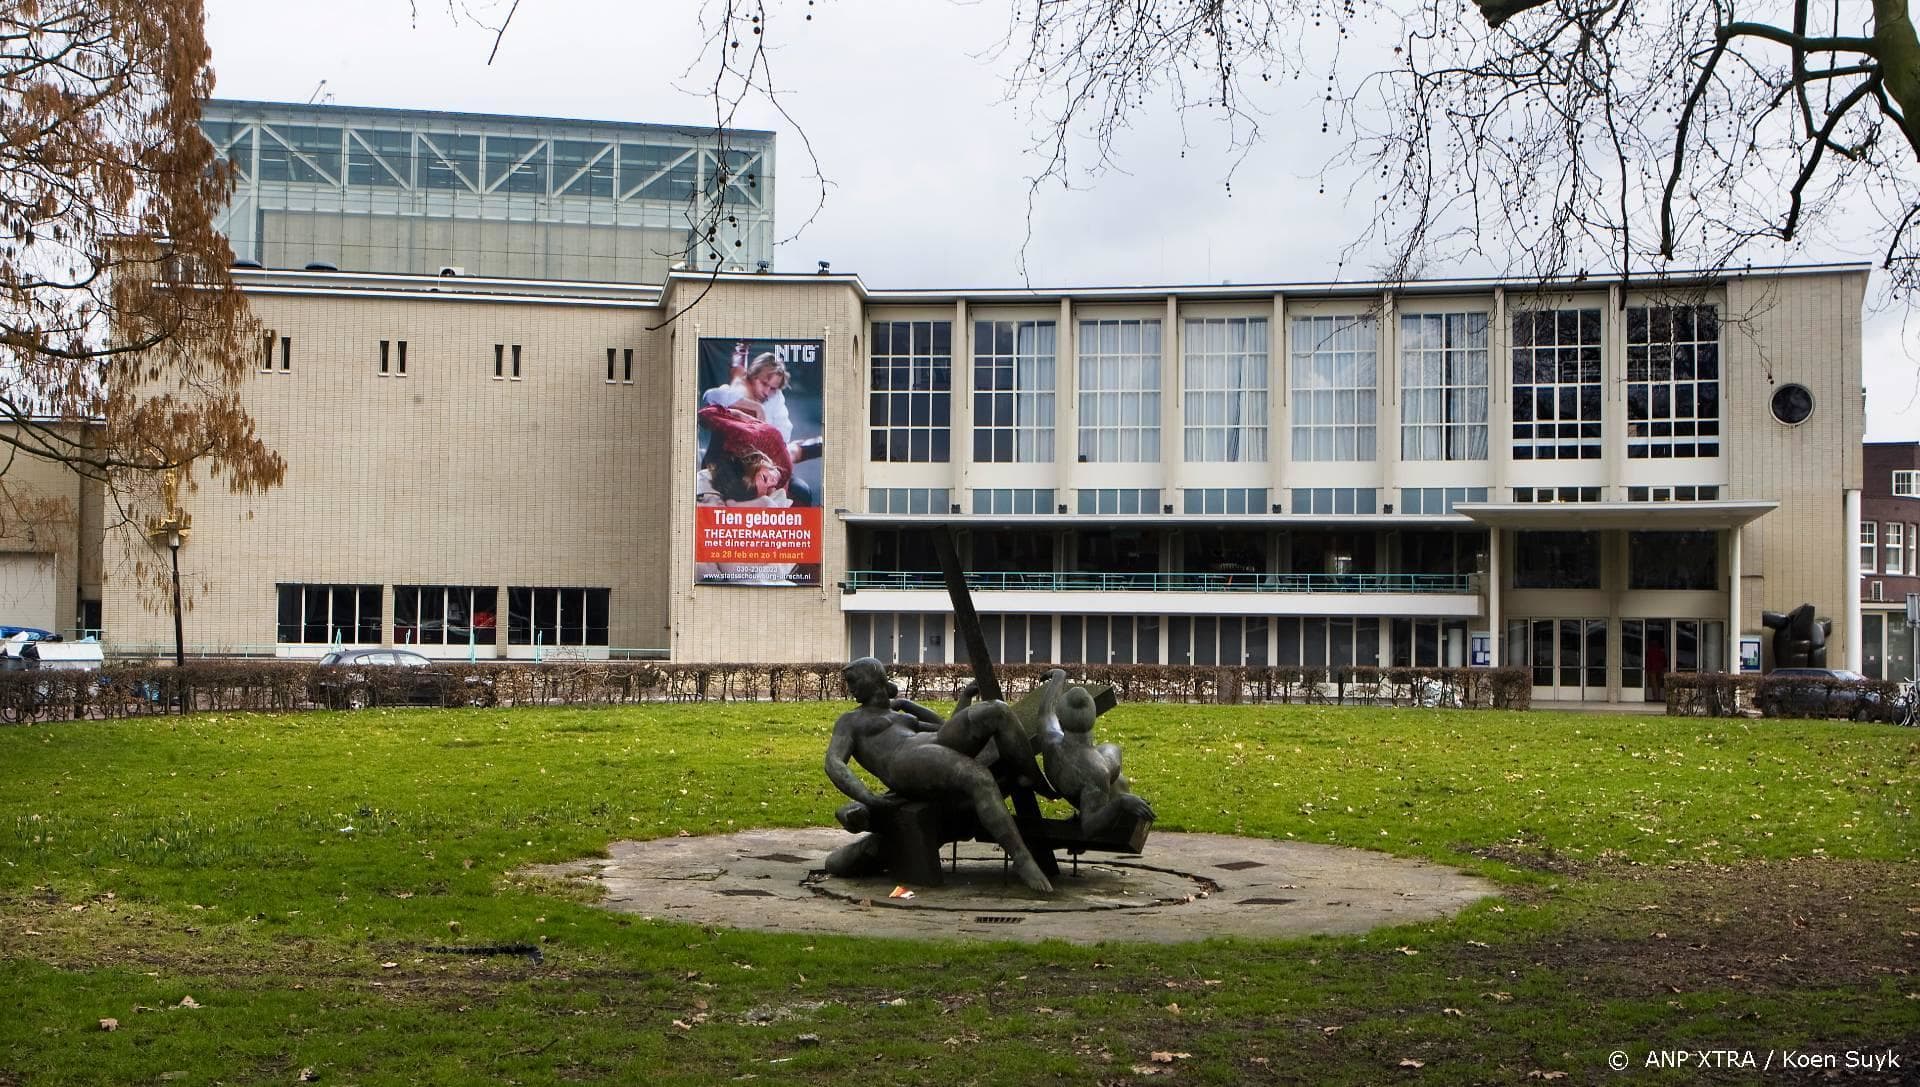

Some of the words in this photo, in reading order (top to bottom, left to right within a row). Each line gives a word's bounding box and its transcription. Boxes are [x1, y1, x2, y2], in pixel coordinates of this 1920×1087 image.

[714, 510, 742, 524] Tien
[746, 511, 802, 527] geboden
[704, 529, 811, 539] THEATERMARATHON
[726, 540, 811, 549] dinerarrangement
[722, 551, 732, 559] 28
[734, 551, 747, 559] feb
[780, 552, 804, 560] maart
